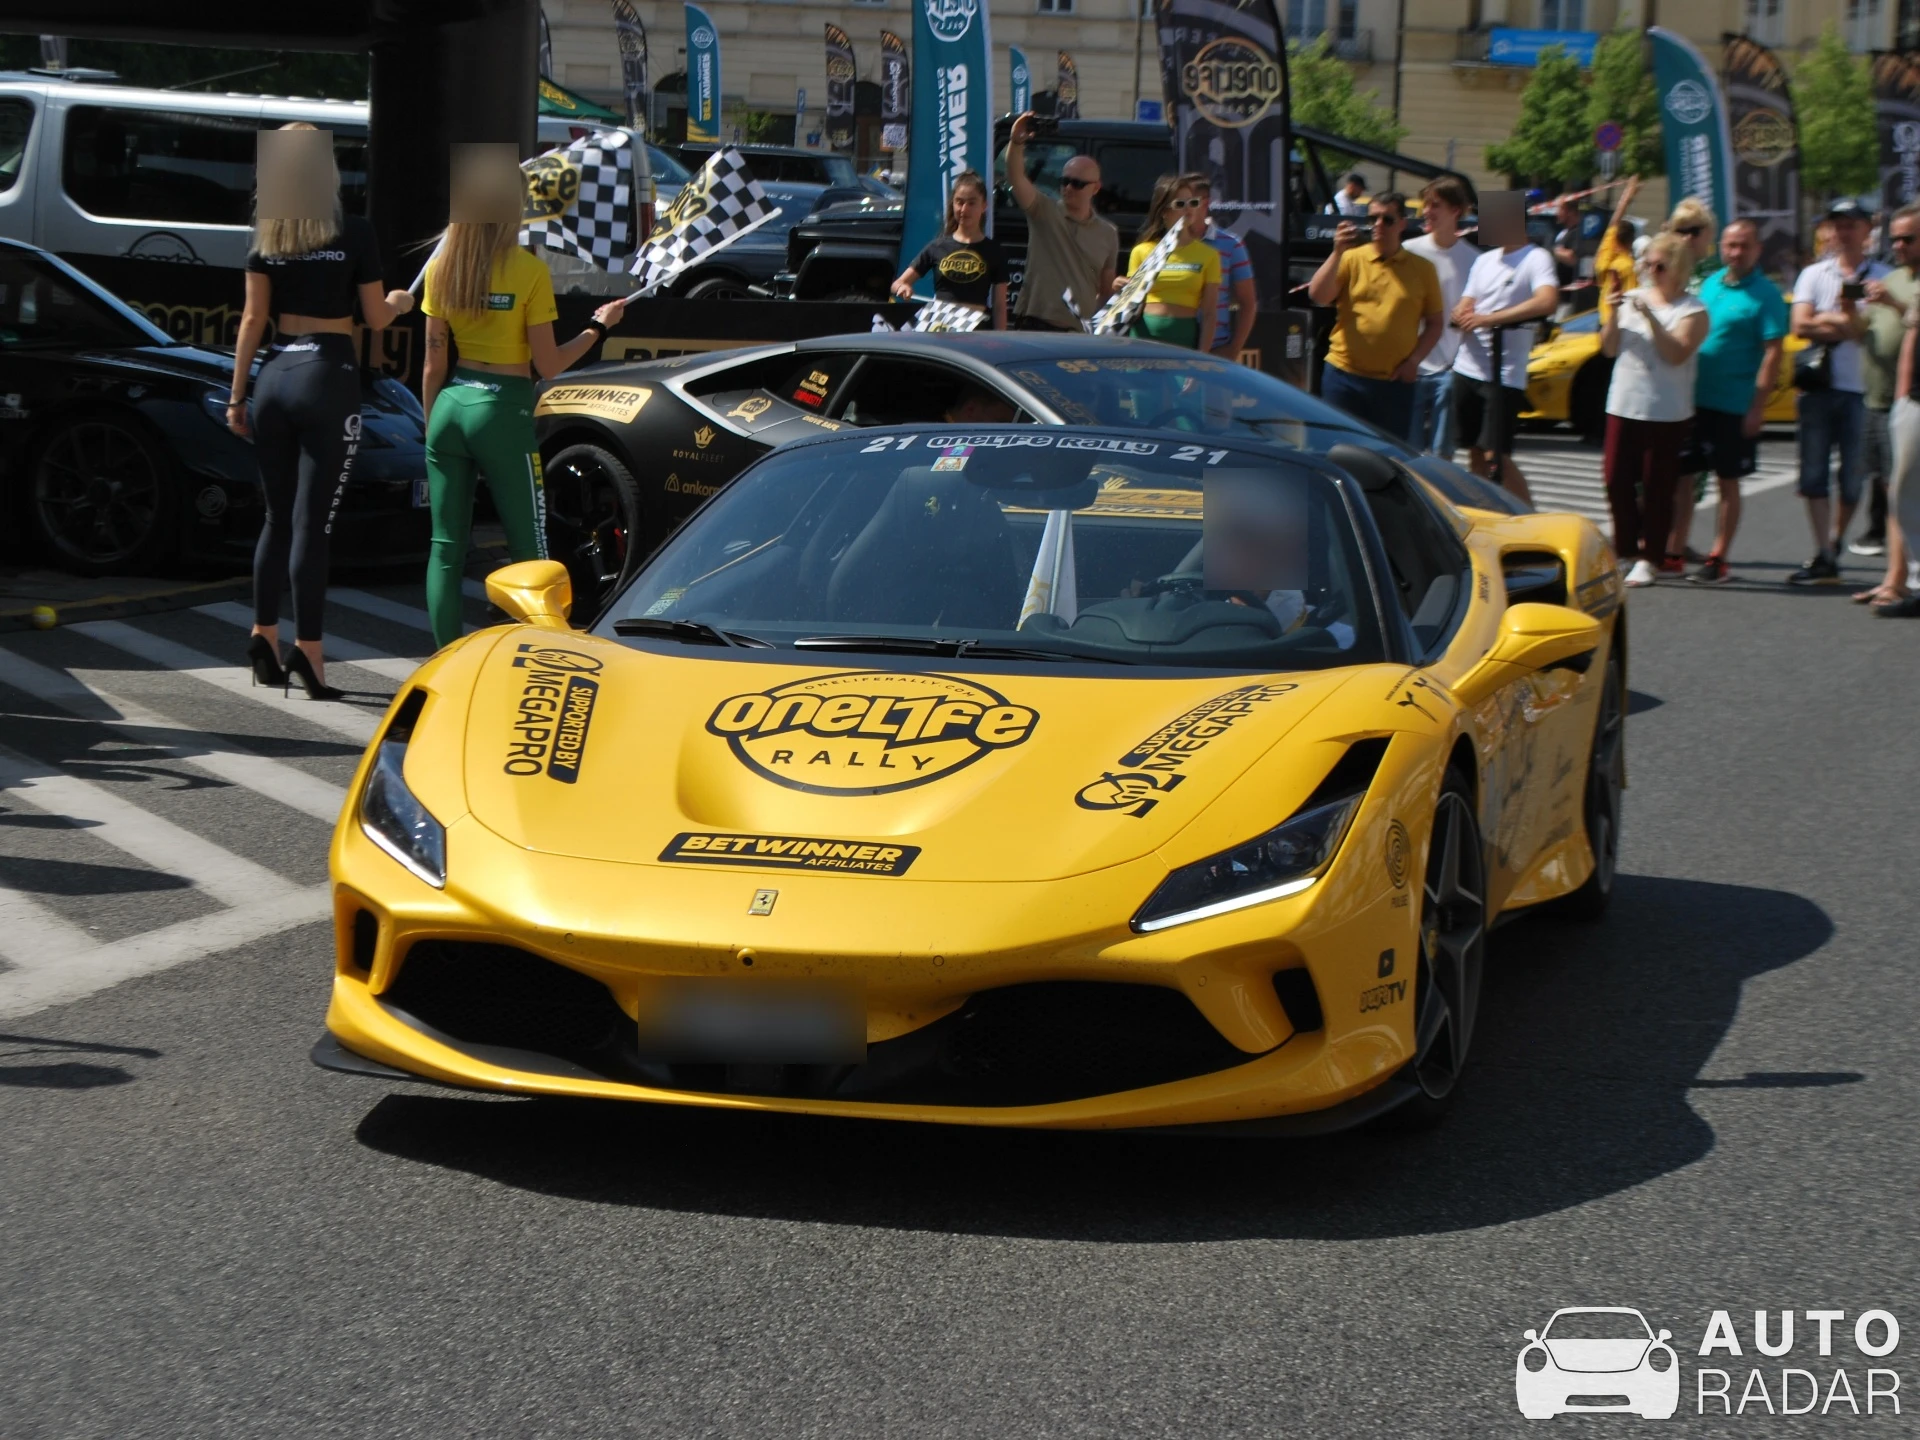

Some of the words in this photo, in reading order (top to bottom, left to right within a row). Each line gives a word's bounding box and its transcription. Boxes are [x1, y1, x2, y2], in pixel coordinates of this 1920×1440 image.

[544, 388, 641, 407] BETWINNER
[587, 403, 630, 417] AFFILIATES
[860, 435, 918, 453] 21
[1169, 446, 1230, 465] 21
[804, 677, 975, 698] ONELIFERALLY.COM
[503, 669, 566, 776] MEGAPRO
[557, 686, 594, 750] SUPPORTED
[1134, 697, 1226, 755] SUPPORTED
[1140, 683, 1299, 772] MEGAPRO
[553, 750, 579, 770] BY
[770, 750, 935, 770] RALLY
[680, 835, 903, 863] BETWINNER
[803, 858, 895, 872] AFFILIATES
